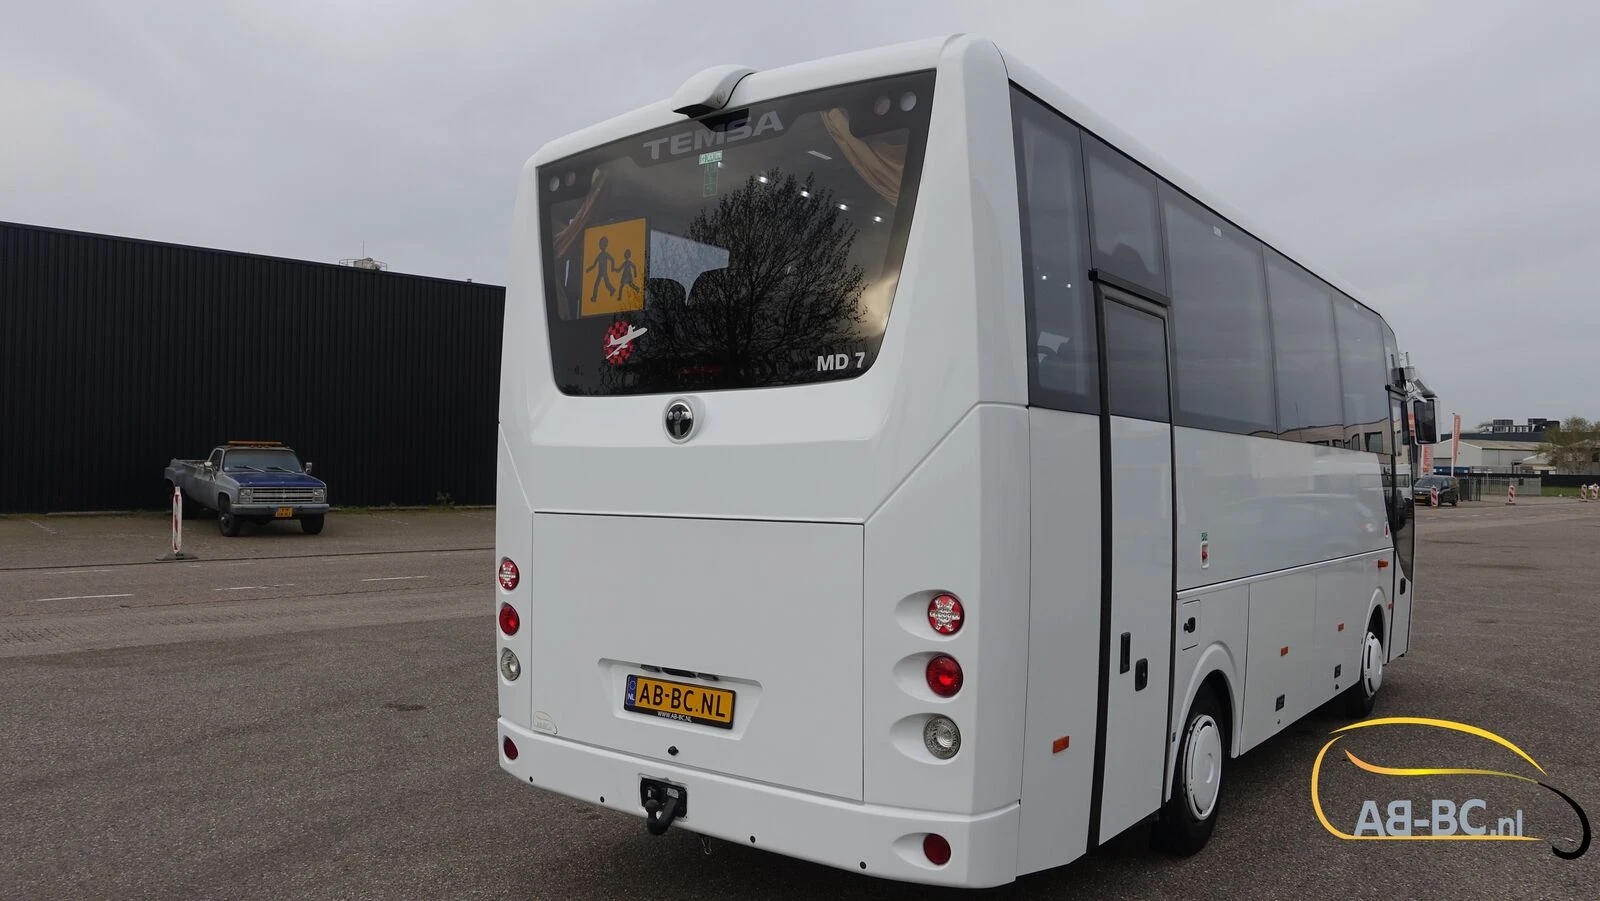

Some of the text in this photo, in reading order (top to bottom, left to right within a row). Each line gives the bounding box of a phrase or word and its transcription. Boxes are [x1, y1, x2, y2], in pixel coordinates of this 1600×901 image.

[643, 111, 784, 160] TEMSA
[817, 351, 866, 371] MD 7
[627, 693, 635, 701] NL
[638, 682, 726, 718] AB-BC.NL
